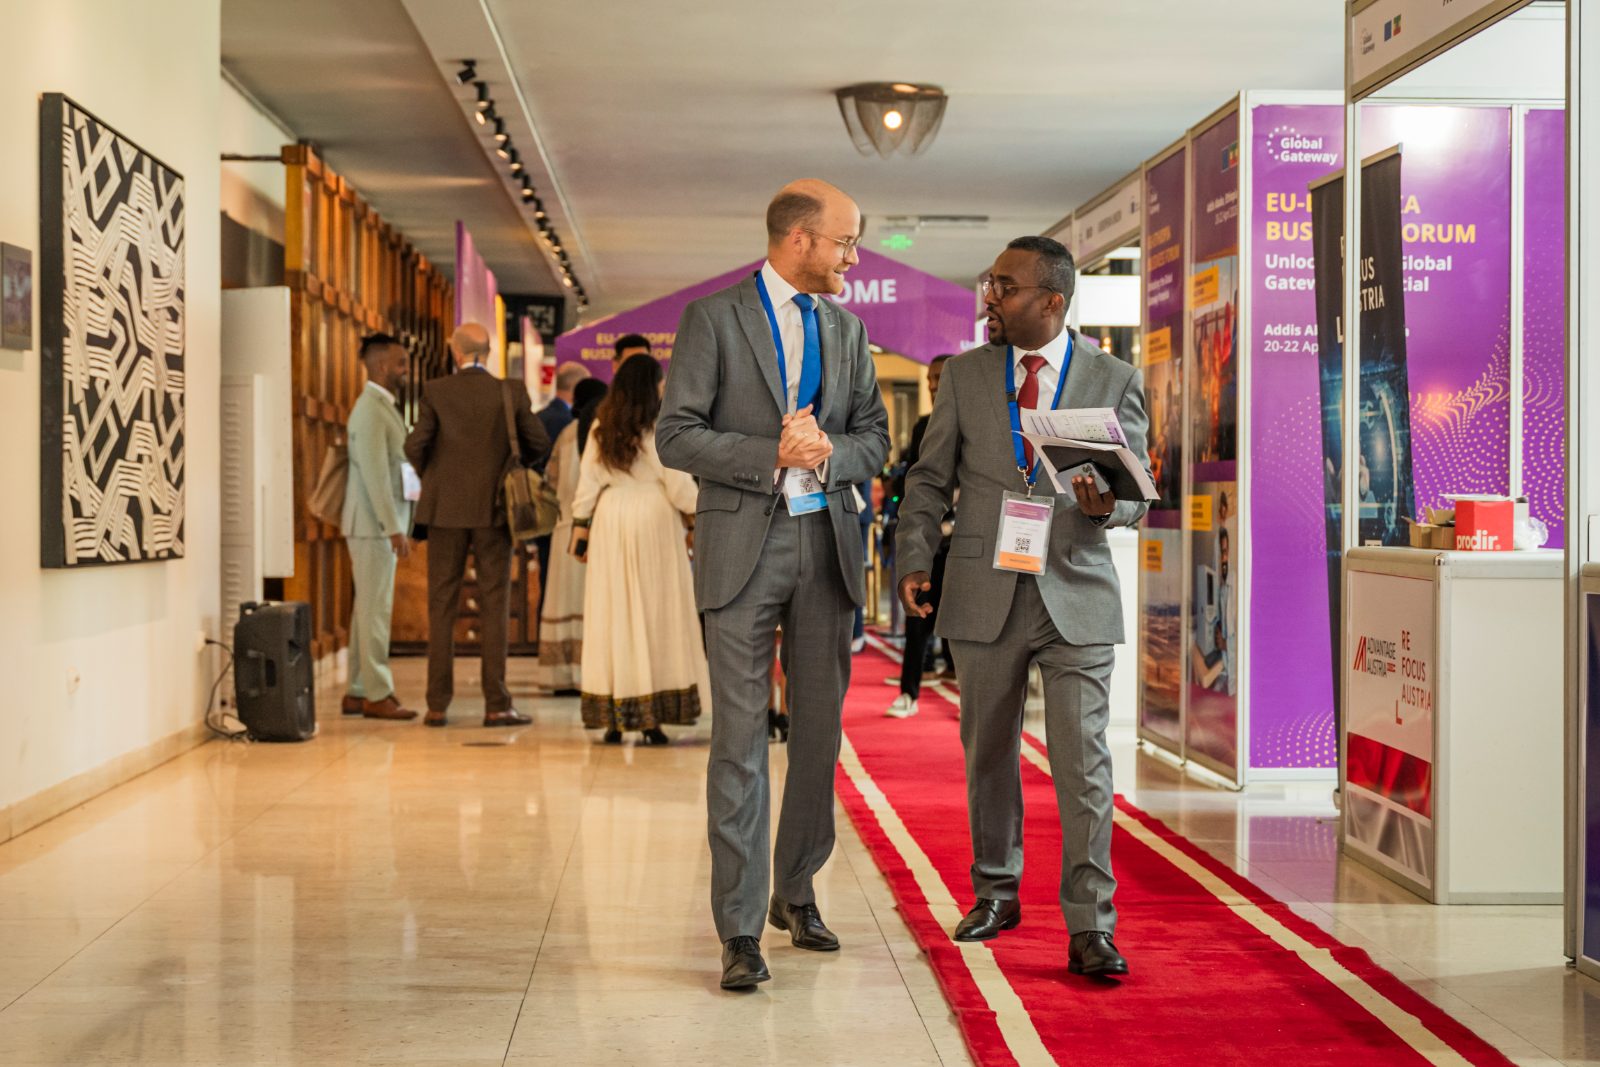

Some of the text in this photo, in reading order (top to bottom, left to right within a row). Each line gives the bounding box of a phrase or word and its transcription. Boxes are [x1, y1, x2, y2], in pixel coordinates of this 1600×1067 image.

[1281, 137, 1323, 149] Global
[1281, 150, 1338, 166] Gateway
[1402, 224, 1476, 243] ORUM
[1265, 254, 1315, 269] Unloc
[830, 279, 897, 304] OME
[1264, 324, 1301, 336] Addis
[1264, 340, 1299, 352] 20-22
[1367, 637, 1396, 660] ADVANTAGE
[1402, 630, 1410, 651] RE
[1367, 658, 1387, 678] AUSTRIA
[1402, 657, 1426, 682] FOCUS
[1402, 683, 1432, 711] AUSTRIA
